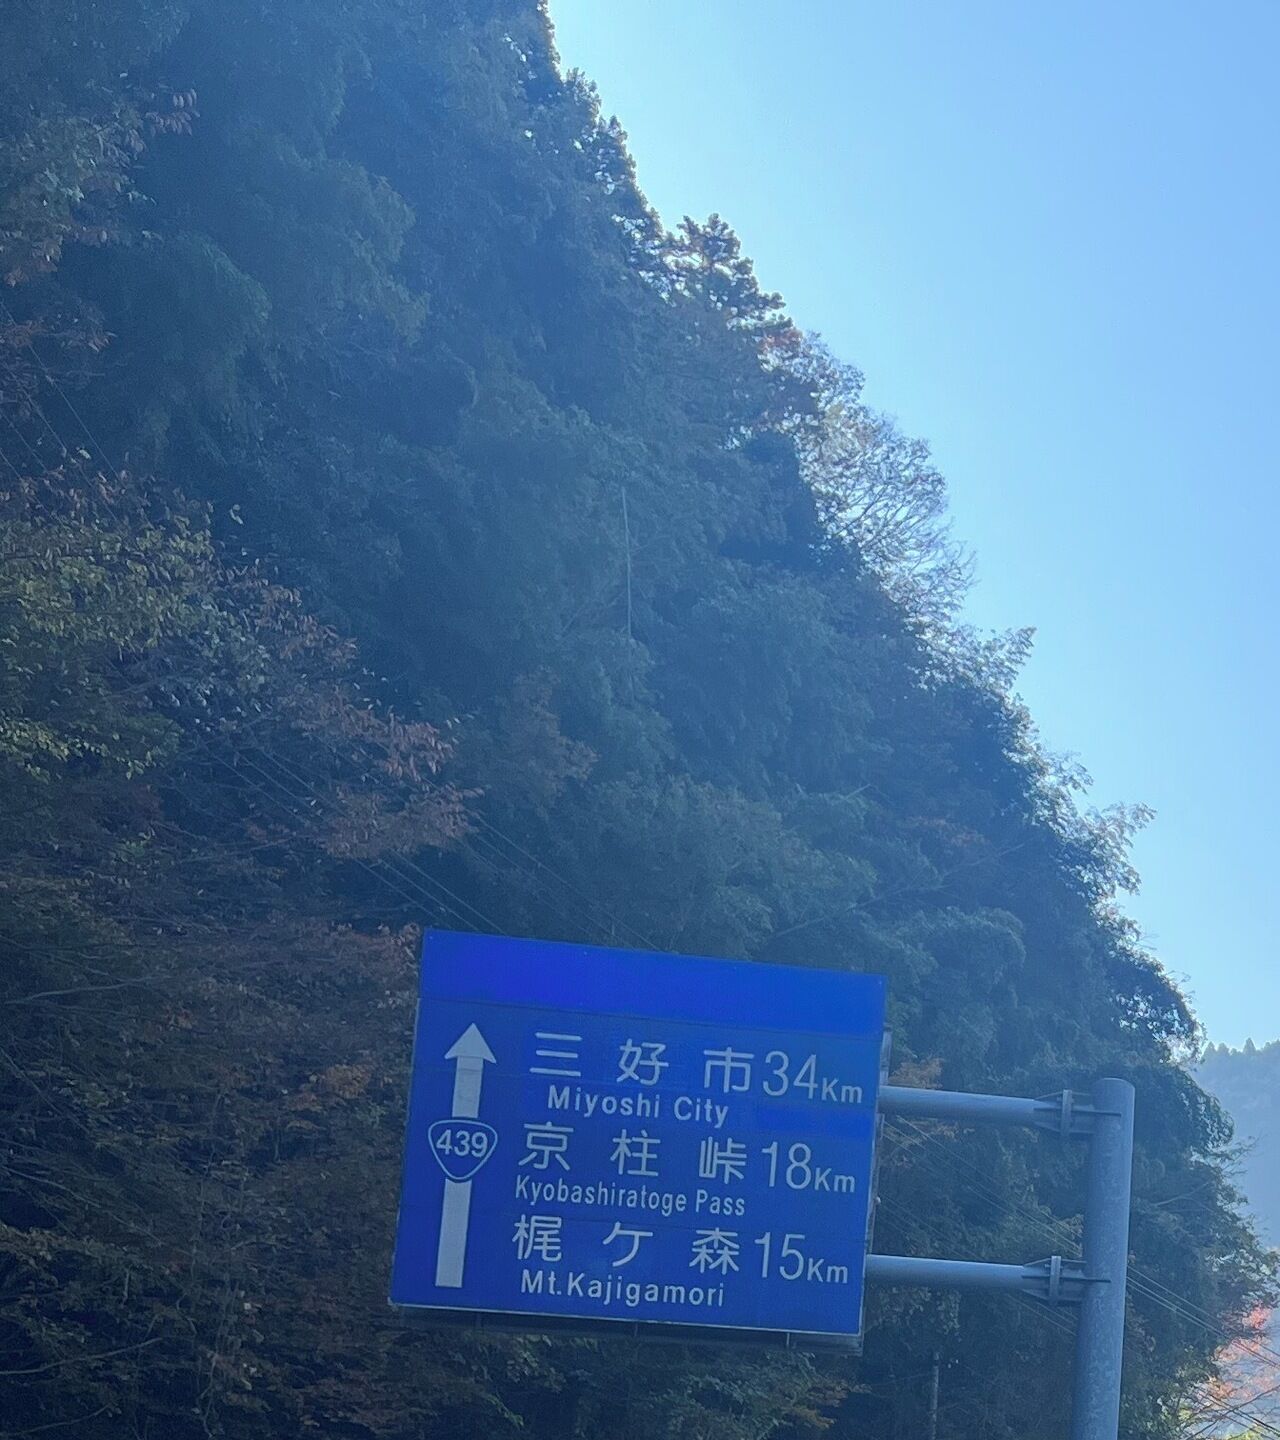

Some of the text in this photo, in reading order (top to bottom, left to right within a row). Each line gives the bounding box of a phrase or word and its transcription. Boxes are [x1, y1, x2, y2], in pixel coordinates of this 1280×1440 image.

[529, 1031, 754, 1095] 三好市
[547, 1086, 729, 1128] Miyoshi City
[434, 1130, 489, 1160] 439
[517, 1121, 748, 1184] 京柱峠
[514, 1175, 746, 1217] Kyobashiratoge Pass
